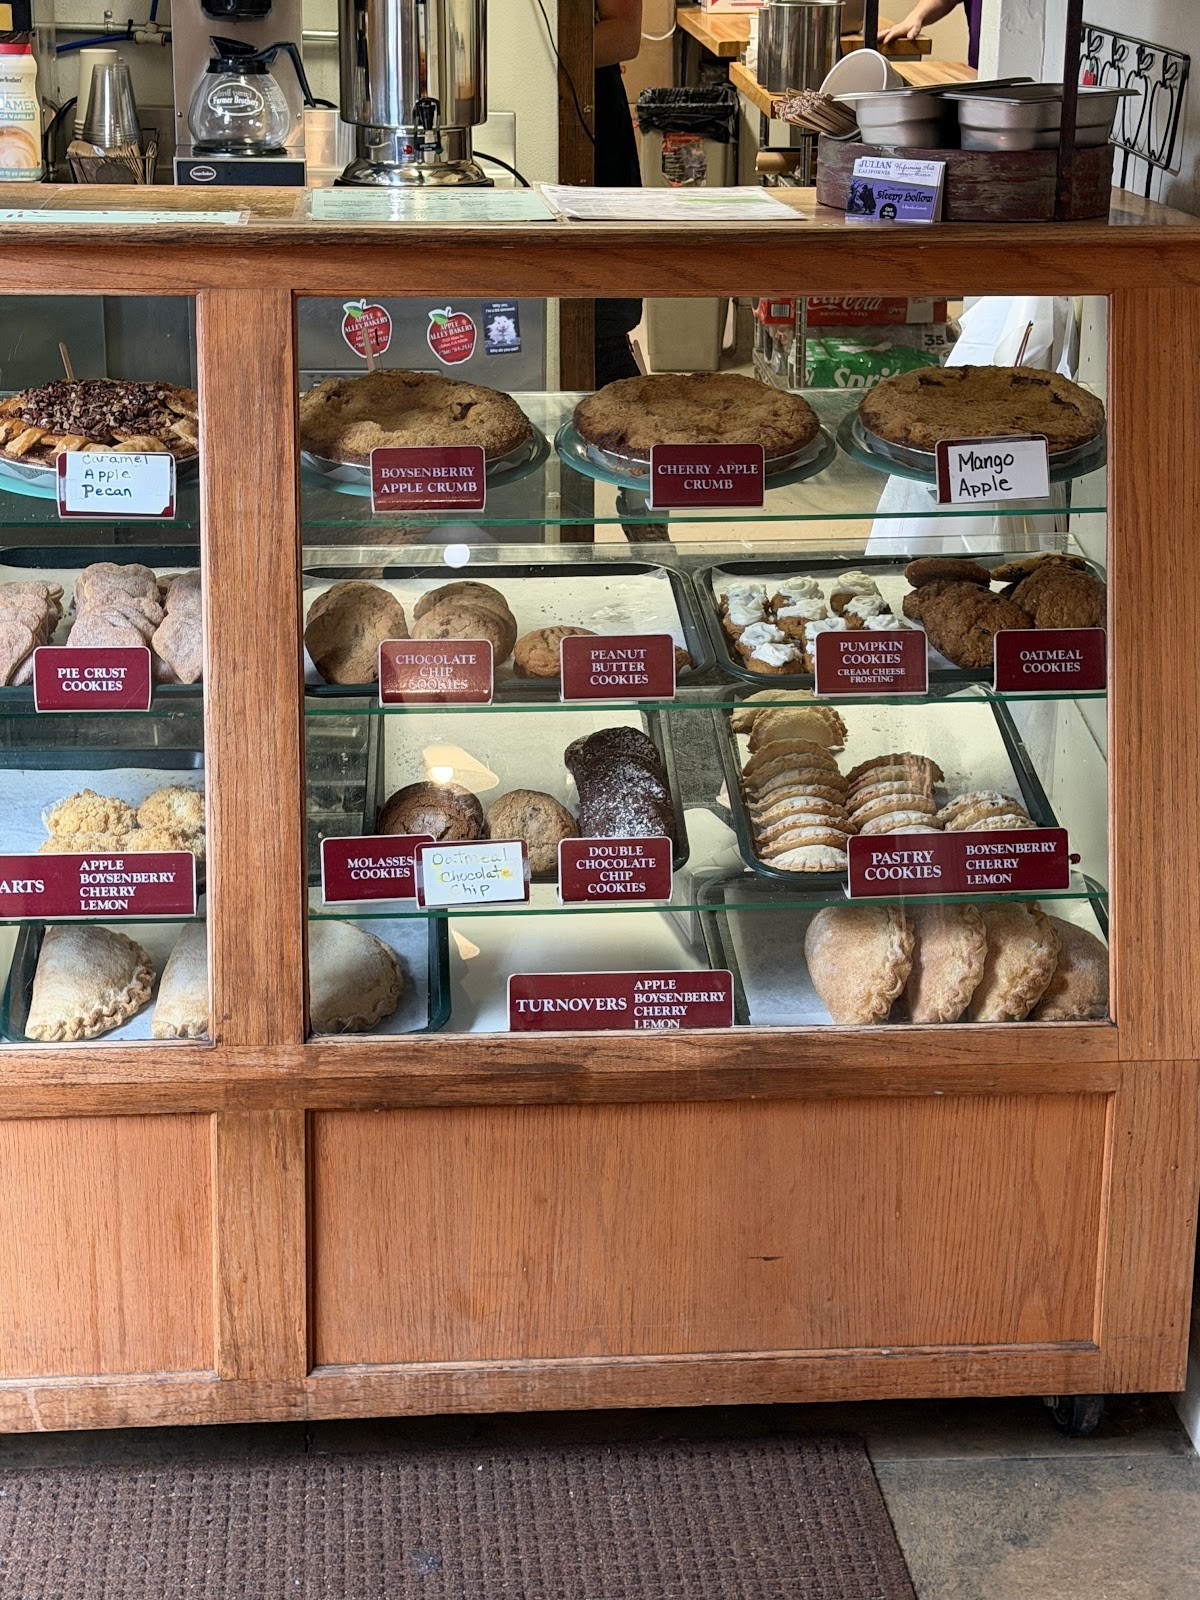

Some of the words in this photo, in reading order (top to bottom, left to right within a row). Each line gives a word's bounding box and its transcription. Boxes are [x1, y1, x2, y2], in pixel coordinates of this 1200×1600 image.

[859, 160, 892, 169] JULIAN
[875, 189, 903, 203] Sleepy
[355, 313, 374, 323] APPLE
[345, 323, 362, 333] ALLEY
[364, 316, 388, 328] BAKERY
[440, 321, 460, 331] APPLE
[430, 331, 448, 340] ALLEY
[449, 324, 473, 336] BAKERY
[833, 367, 900, 388] Spri
[82, 454, 149, 465] Caramel
[958, 451, 1014, 474] Mango
[381, 466, 475, 478] BOYSENBERRY
[658, 464, 711, 475] CHERRY
[716, 464, 759, 475] APPLE
[84, 469, 131, 483] Apple
[381, 483, 423, 493] APPLE
[427, 482, 478, 493] CRUMB
[683, 479, 734, 490] CRUMB
[959, 475, 1013, 498] Apple
[81, 485, 132, 498] Pecan
[840, 641, 903, 652] PUMPKIN
[395, 654, 477, 665] CHOCOLATE
[590, 649, 646, 660] PEANUT
[842, 653, 901, 665] COOKIES
[1020, 650, 1083, 661] OATMEAL
[419, 667, 453, 677] CHIP
[592, 661, 646, 673] BUTTER
[837, 668, 870, 676] CREAM
[872, 667, 906, 676] CHEESE
[1022, 662, 1081, 673] COOKIES
[57, 668, 80, 679] PIE
[84, 667, 127, 678] CRUST
[408, 679, 469, 690] COOKIES
[590, 674, 649, 685] COOKIES
[850, 676, 894, 684] FROSTING
[62, 680, 123, 691] COOKIES
[588, 845, 644, 856] DOUBLE
[966, 842, 1057, 856] BOYSENBERRY
[347, 855, 414, 868] MOLASSES
[432, 848, 507, 866] Oatmeal
[871, 850, 935, 865] PASTRY
[79, 860, 124, 871] APPLE
[576, 858, 657, 869] CHOCOLATE
[965, 858, 1019, 870] CHERRY
[80, 872, 176, 884] BOYSENBERRY
[351, 868, 411, 880] COOKIES
[600, 871, 633, 881] CHIP
[864, 865, 942, 881] COOKIES
[967, 873, 1012, 885] LEMON
[0, 880, 45, 894] ARTS
[79, 886, 136, 897] CHERRY
[587, 883, 646, 893] COOKIES
[80, 899, 128, 911] LEMON
[633, 980, 677, 991] APPLE
[634, 992, 726, 1004] BOYSENBERRY
[516, 997, 627, 1013] TURNOVERS
[633, 1005, 688, 1017] CHERRY
[634, 1019, 680, 1030] LEMON
